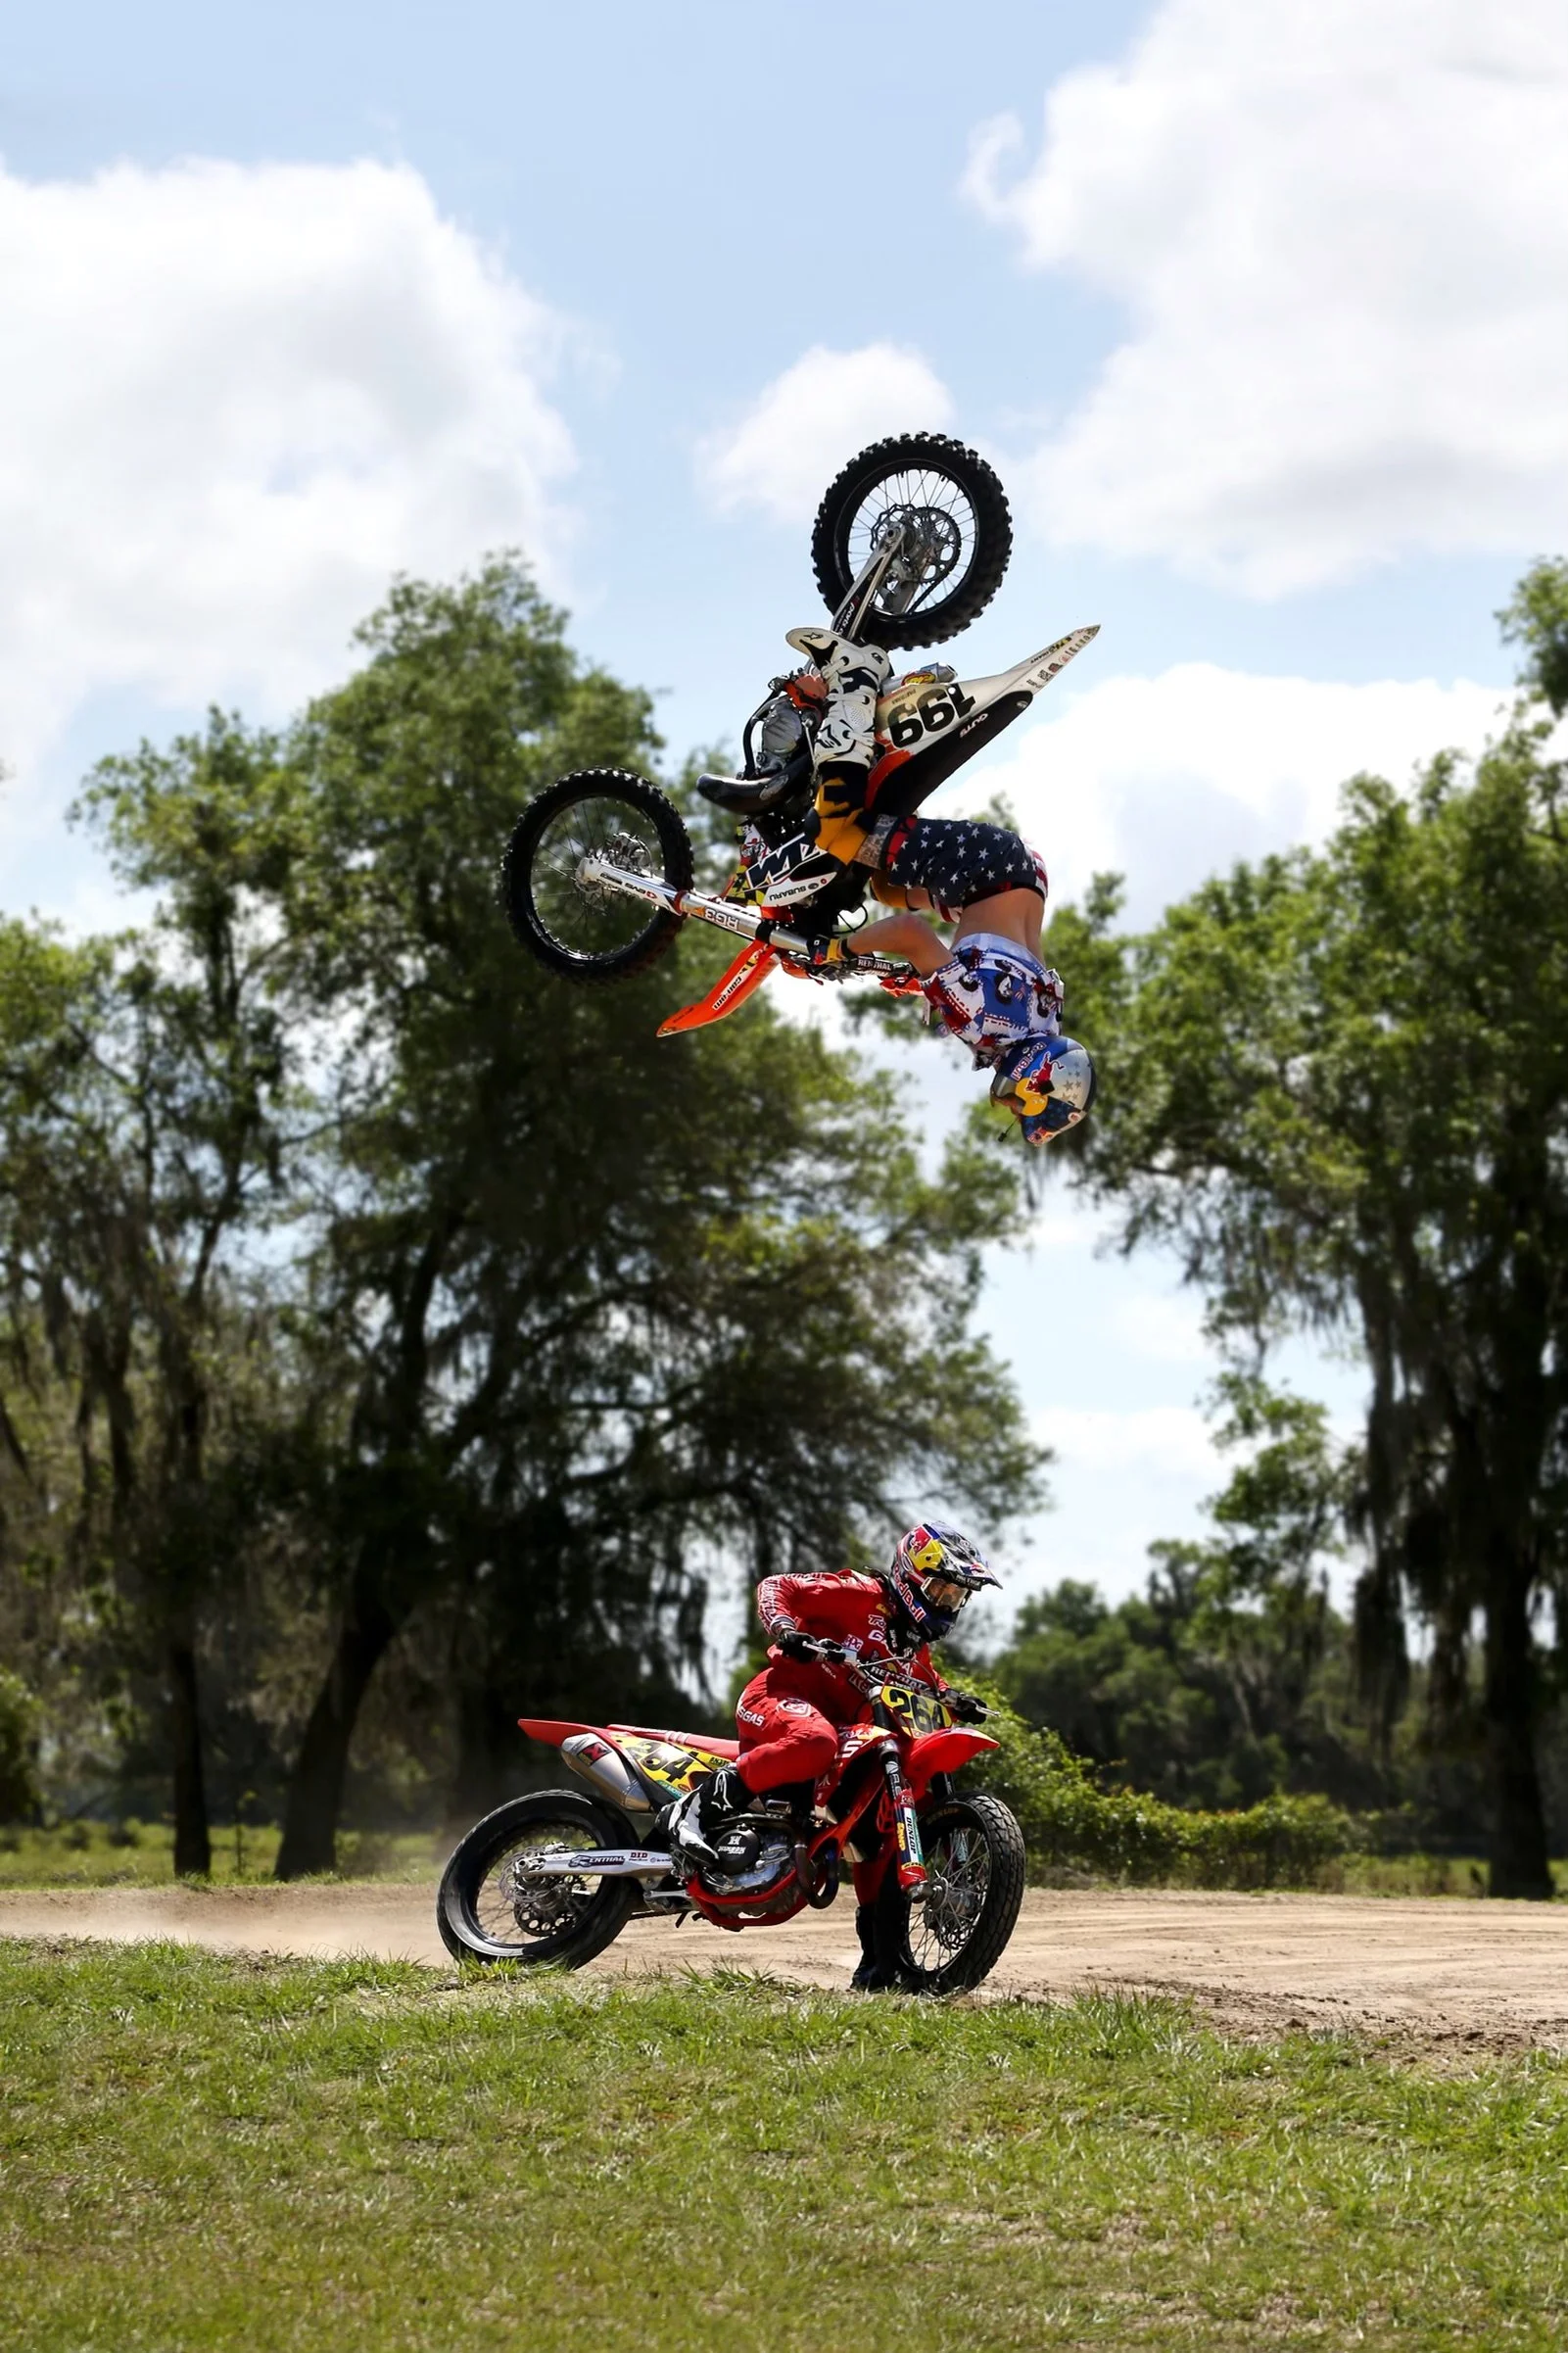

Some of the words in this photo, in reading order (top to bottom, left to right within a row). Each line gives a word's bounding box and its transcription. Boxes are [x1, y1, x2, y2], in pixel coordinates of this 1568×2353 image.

[886, 683, 976, 748] 199
[769, 885, 807, 901] SUBARU
[704, 907, 739, 931] RG3
[888, 1688, 944, 1734] 264
[625, 1741, 698, 1783] 264
[906, 1816, 917, 1854] DUNLOP
